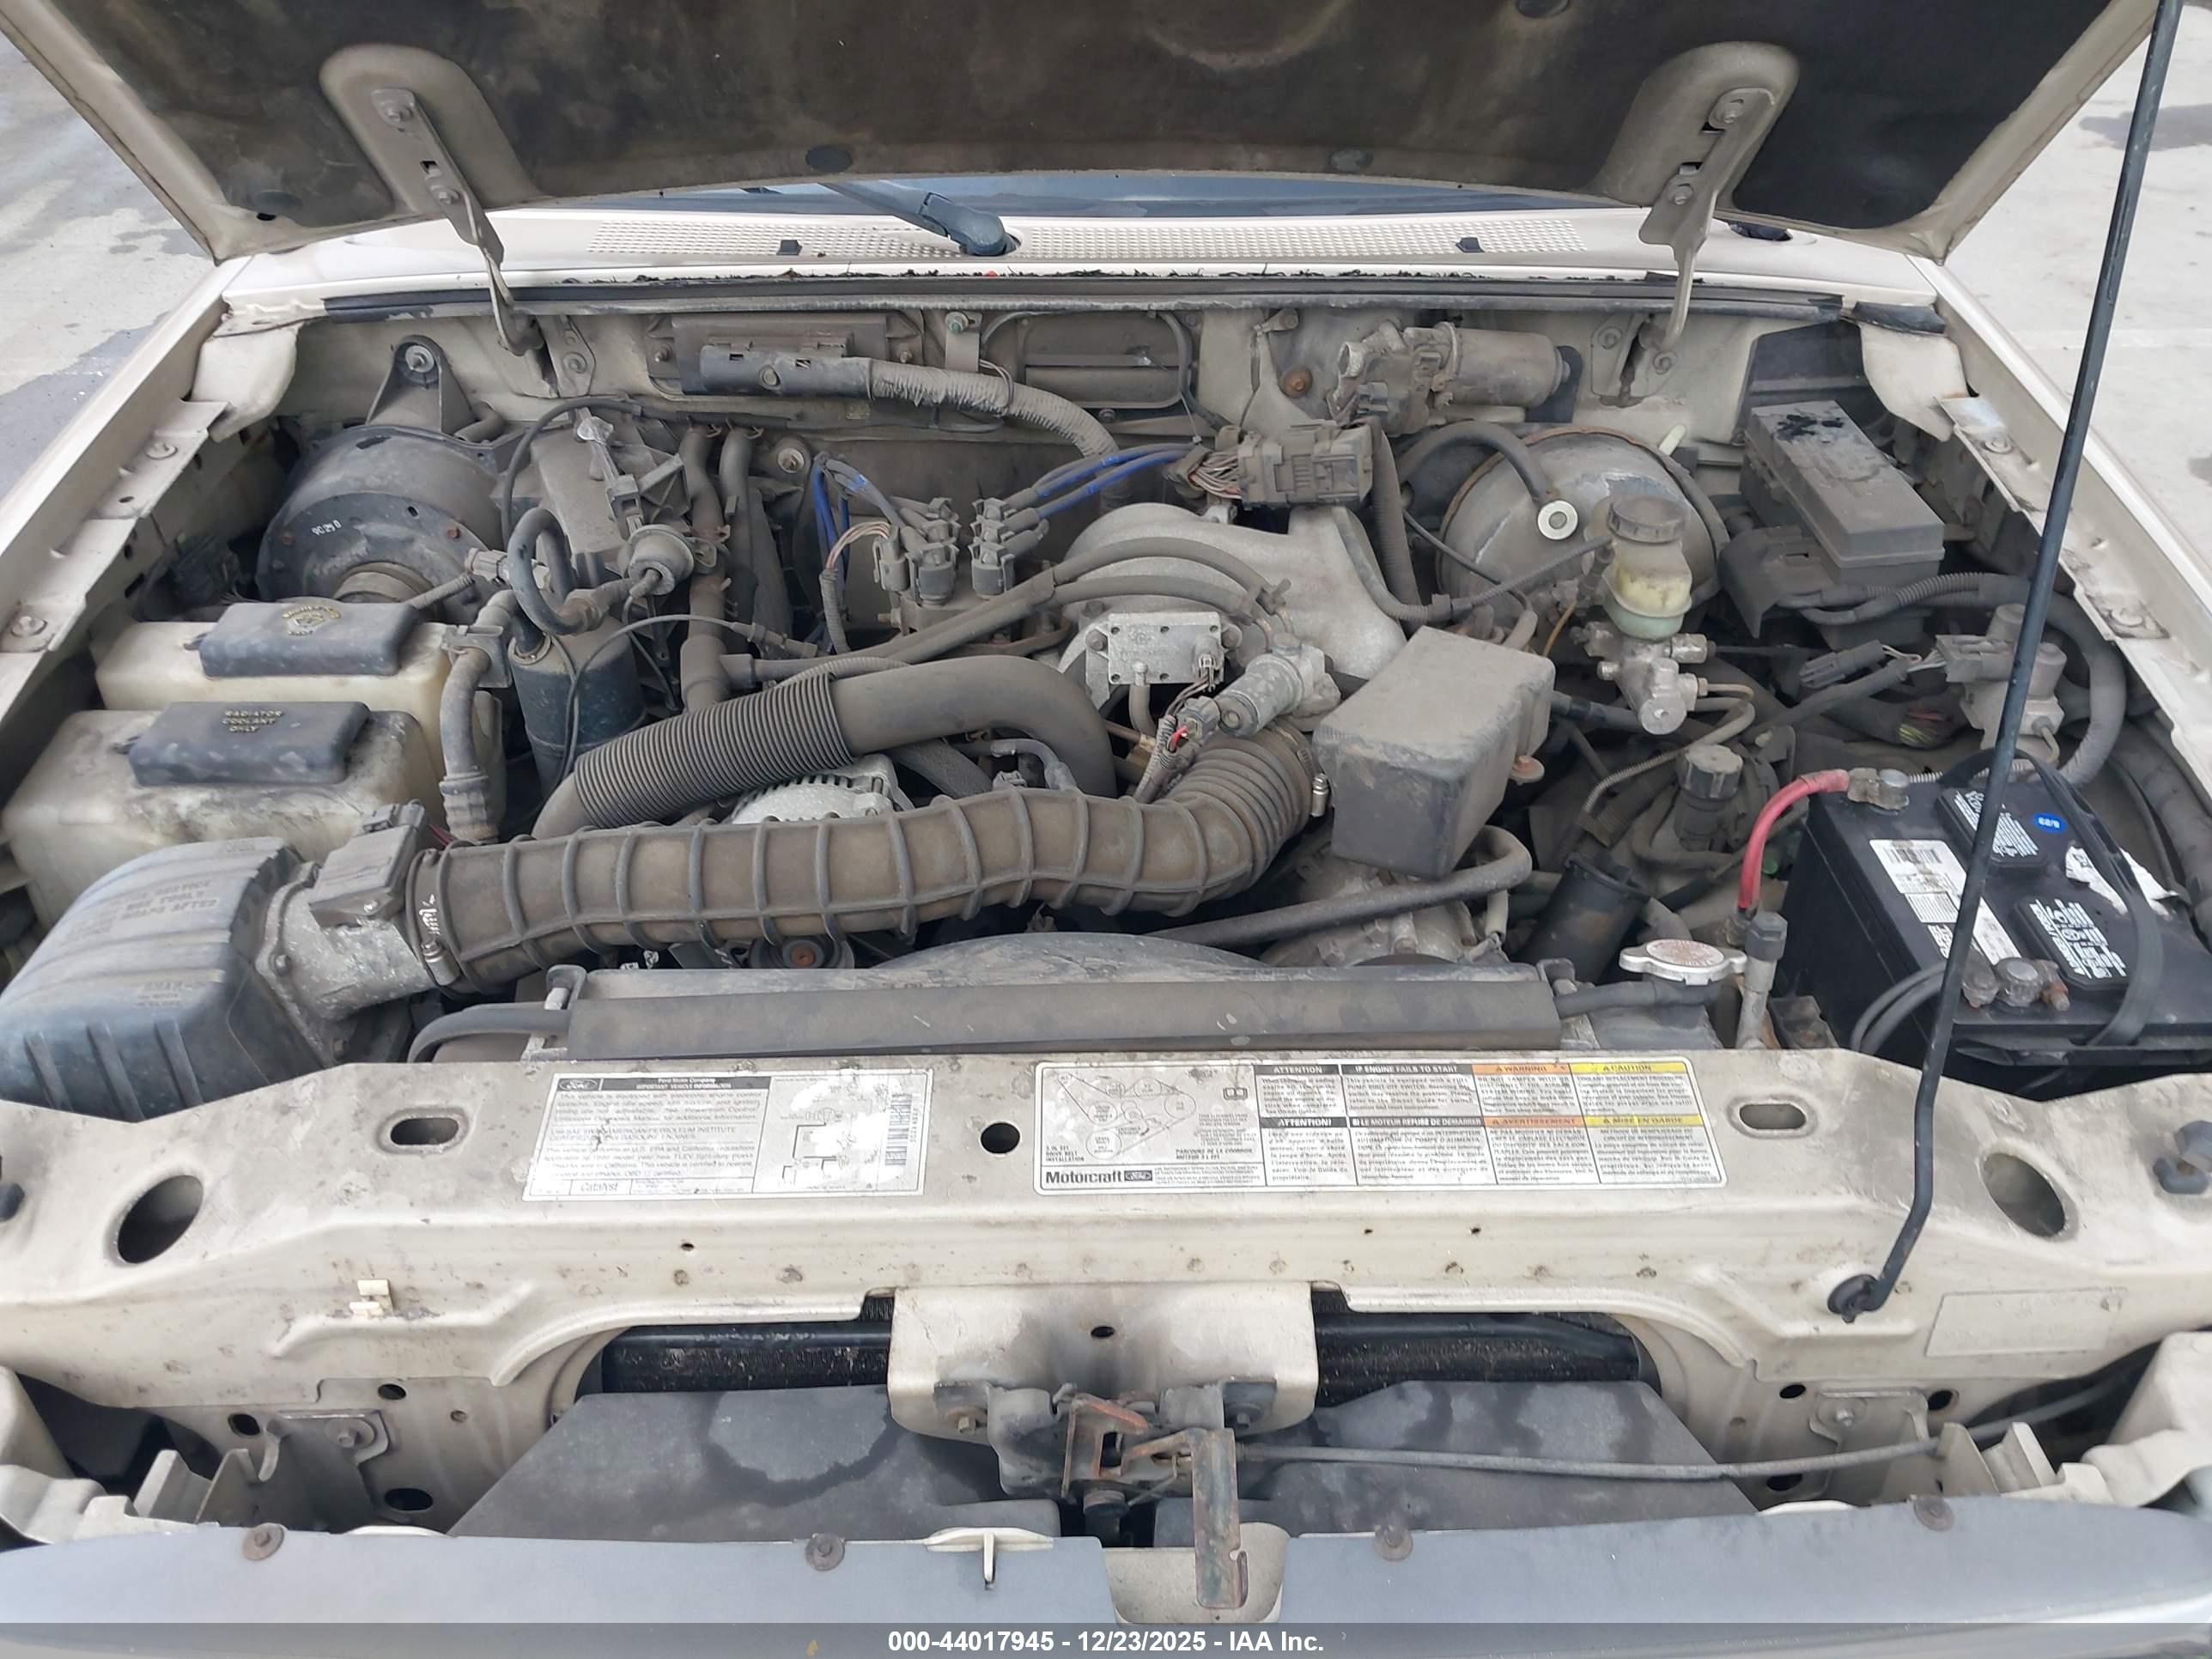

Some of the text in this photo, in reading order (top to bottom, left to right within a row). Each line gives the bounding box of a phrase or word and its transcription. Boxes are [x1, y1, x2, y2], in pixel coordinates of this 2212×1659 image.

[1278, 1118, 1332, 1127] ATTENTION!
[1046, 1170, 1121, 1183] Motorcraft
[580, 1182, 618, 1192] Catalyst
